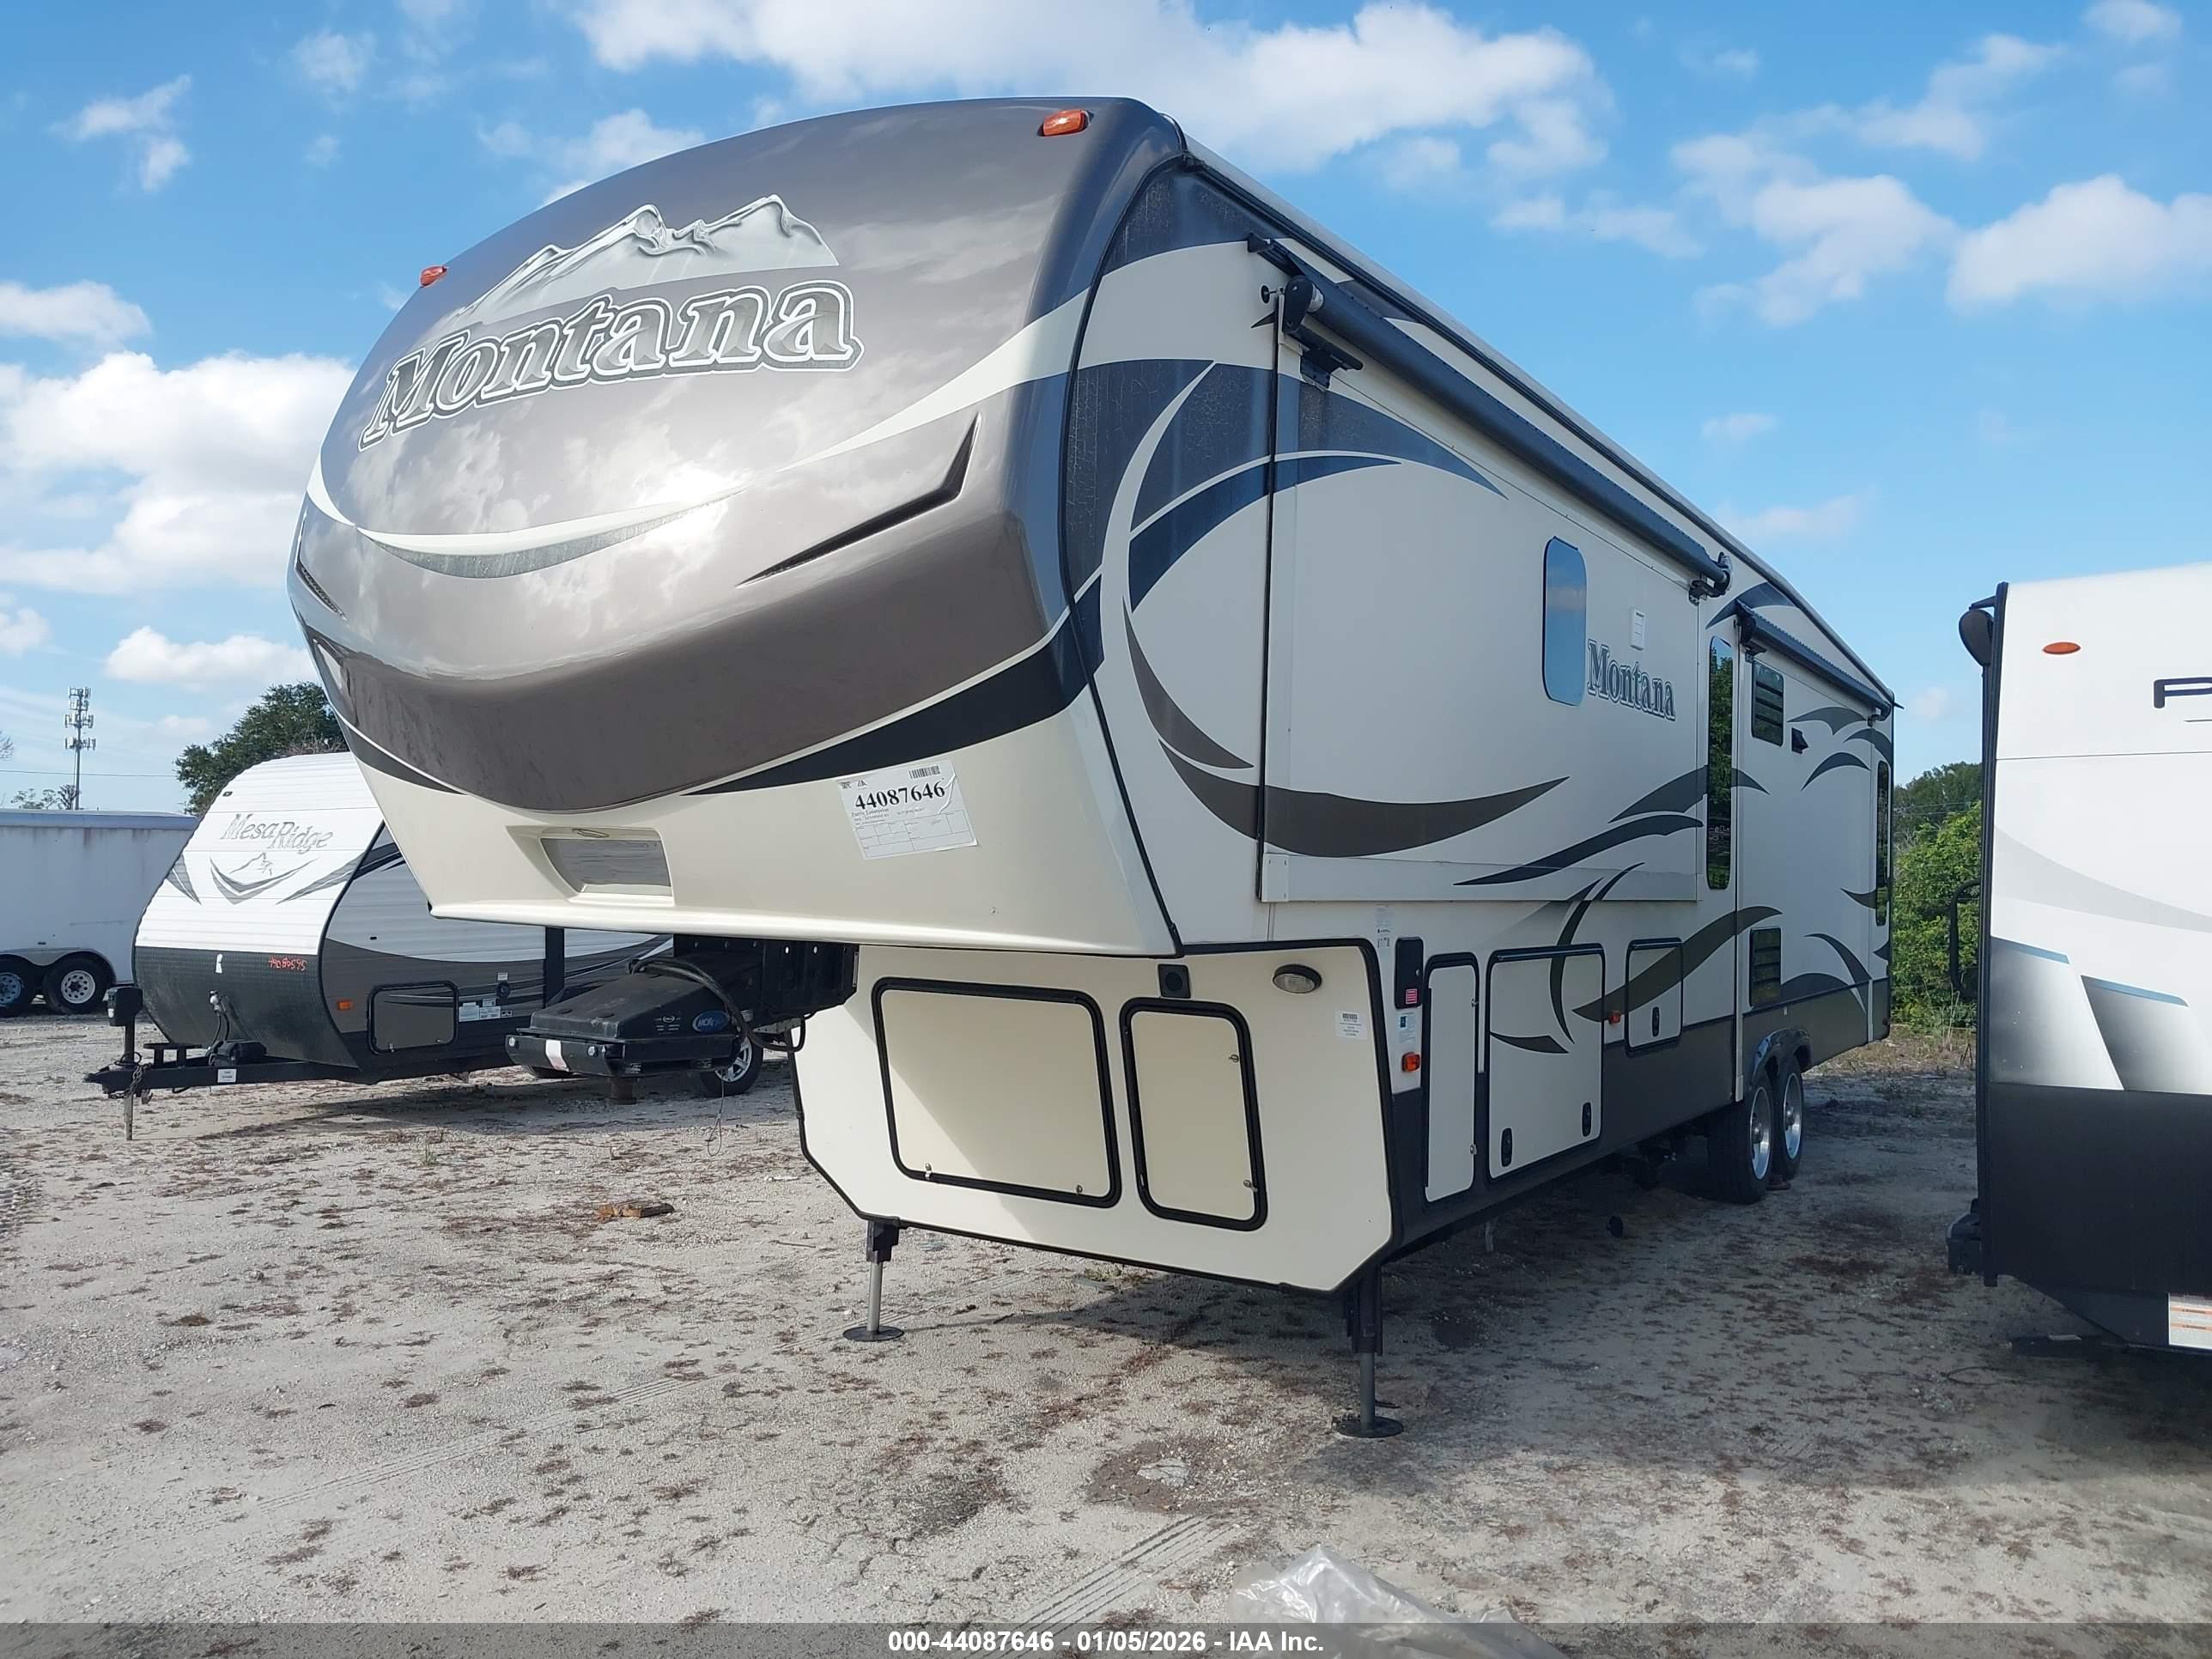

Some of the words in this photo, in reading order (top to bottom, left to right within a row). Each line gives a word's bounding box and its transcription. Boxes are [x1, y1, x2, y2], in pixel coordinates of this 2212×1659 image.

[358, 279, 864, 452] Montana
[1588, 639, 1676, 721] Montana
[855, 781, 945, 810] 44087646
